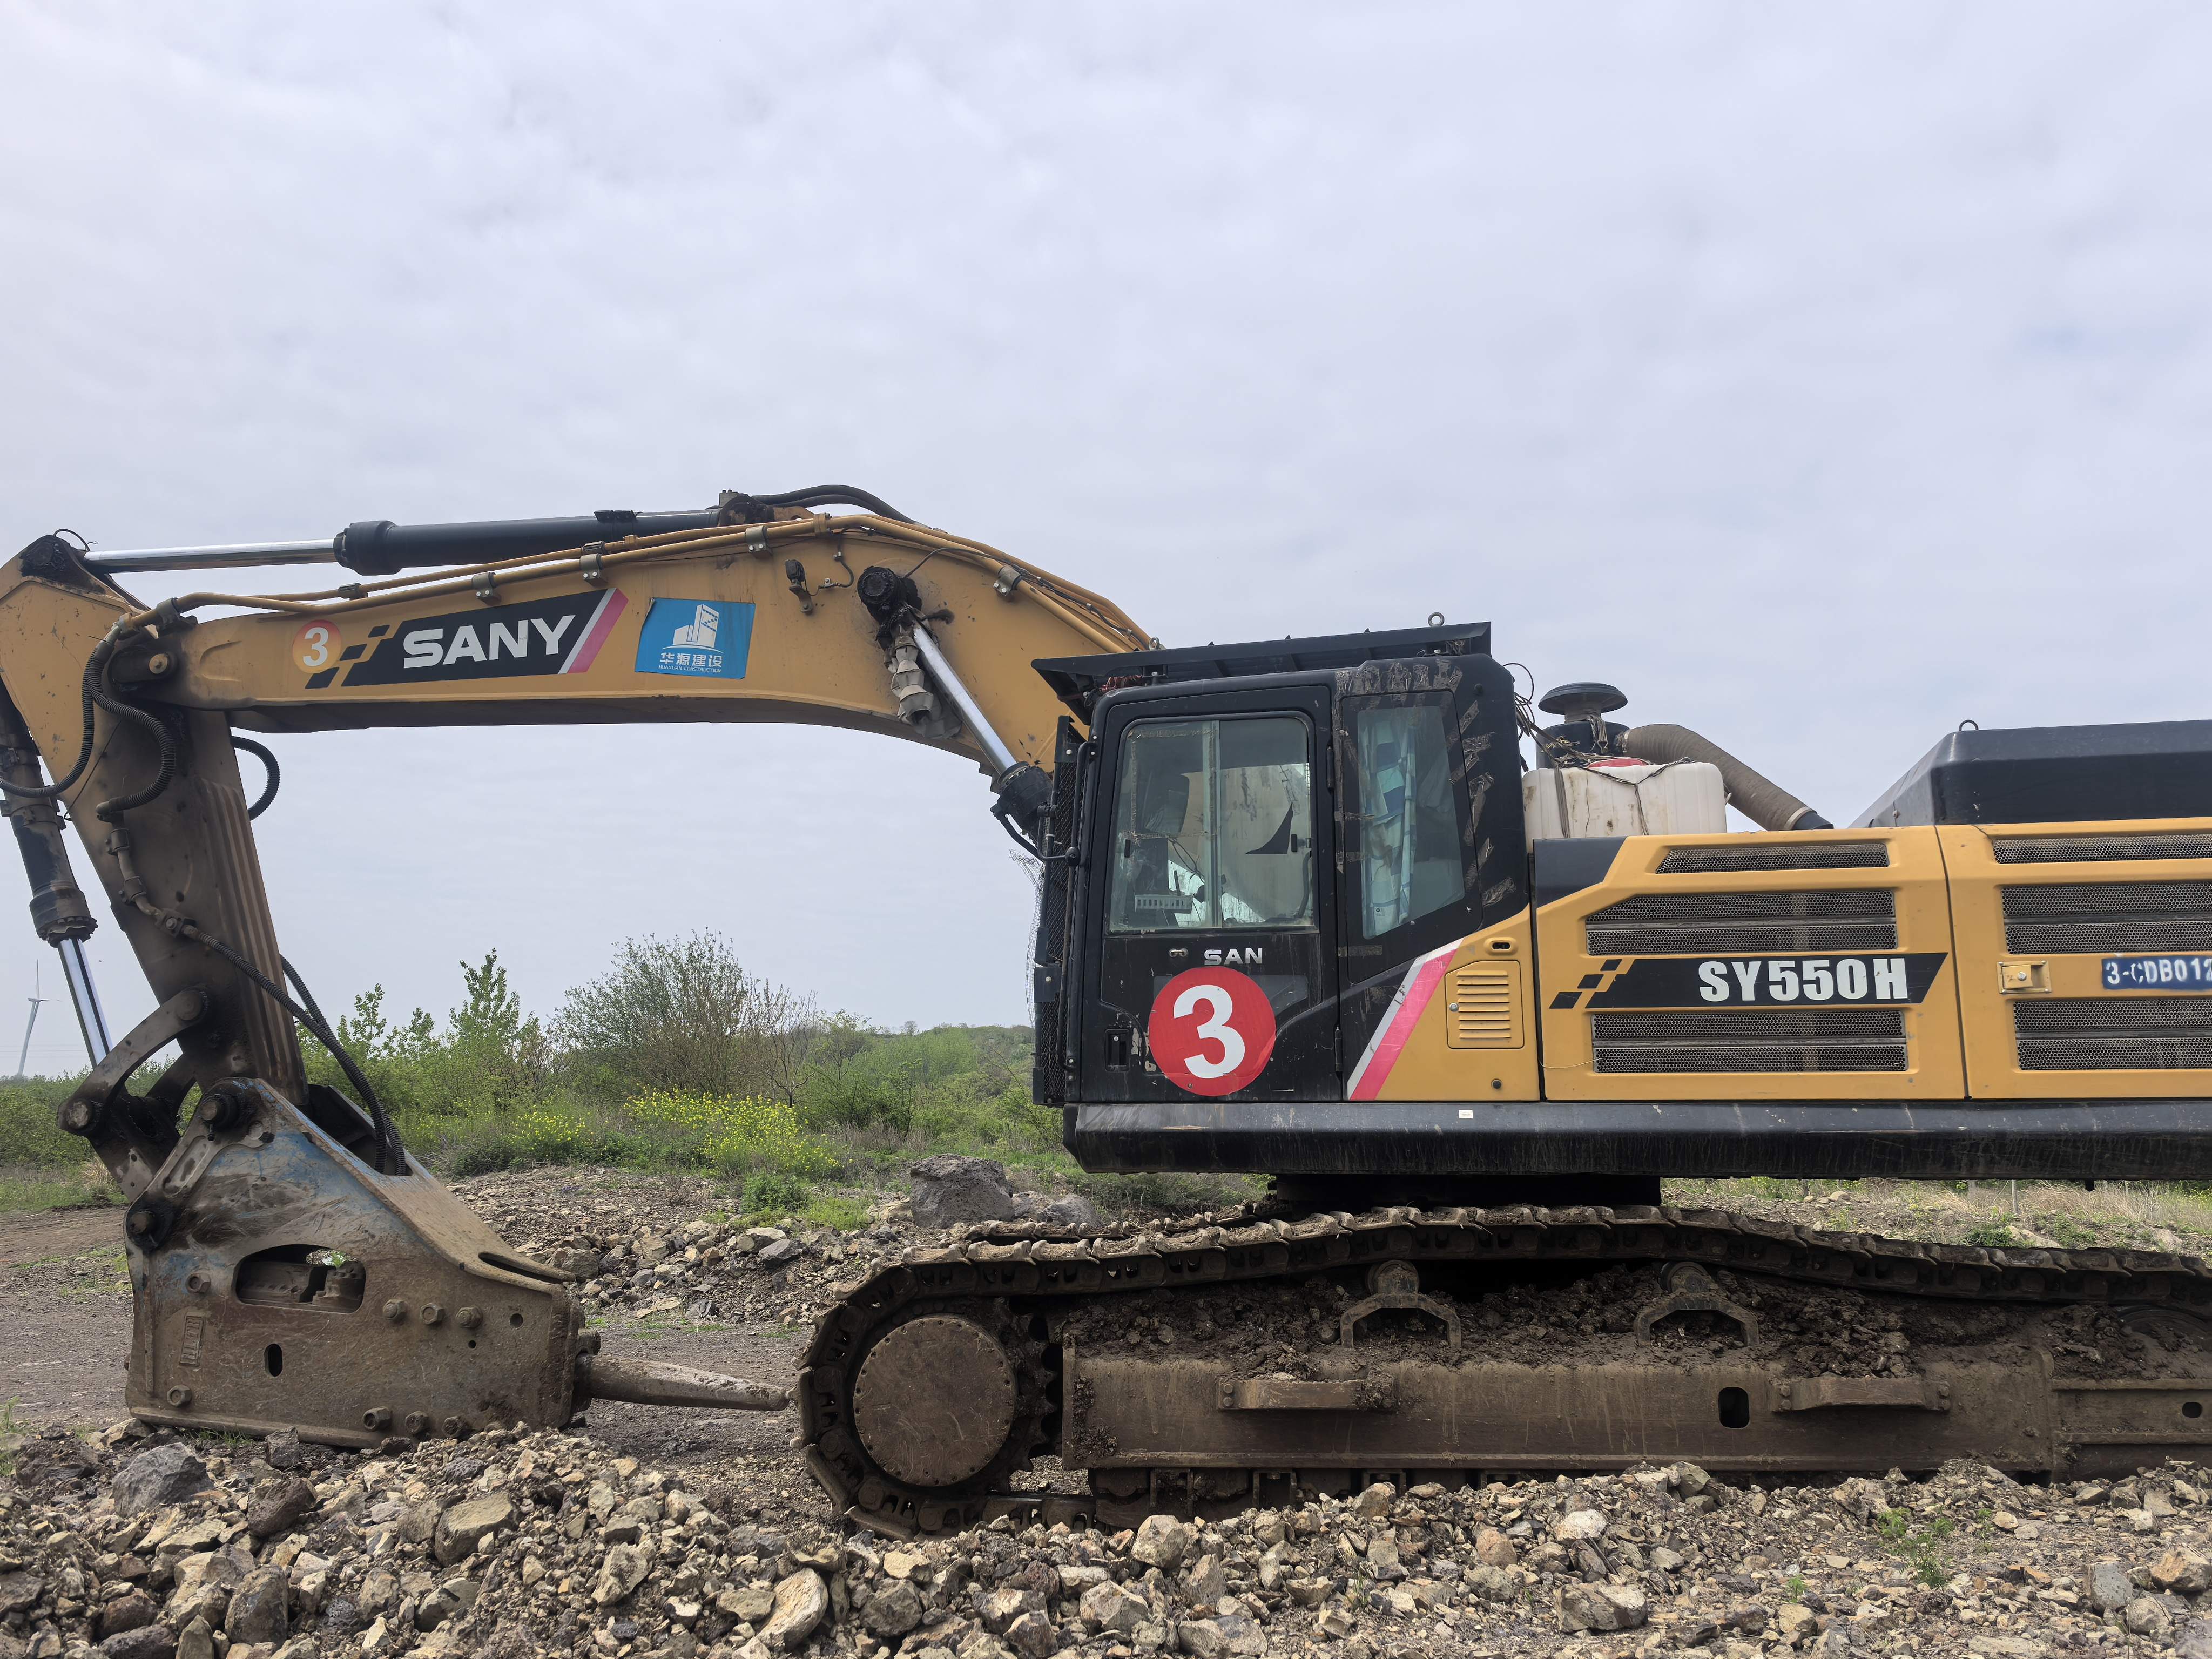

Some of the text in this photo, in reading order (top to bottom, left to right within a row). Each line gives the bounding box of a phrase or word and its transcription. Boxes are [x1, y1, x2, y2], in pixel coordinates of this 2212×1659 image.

[303, 627, 329, 667] 3
[403, 615, 576, 669] SANY
[659, 652, 723, 667] 华源建设
[1204, 948, 1263, 966] SAN
[1698, 957, 1908, 1002] SY550H
[1173, 984, 1245, 1079] 3
